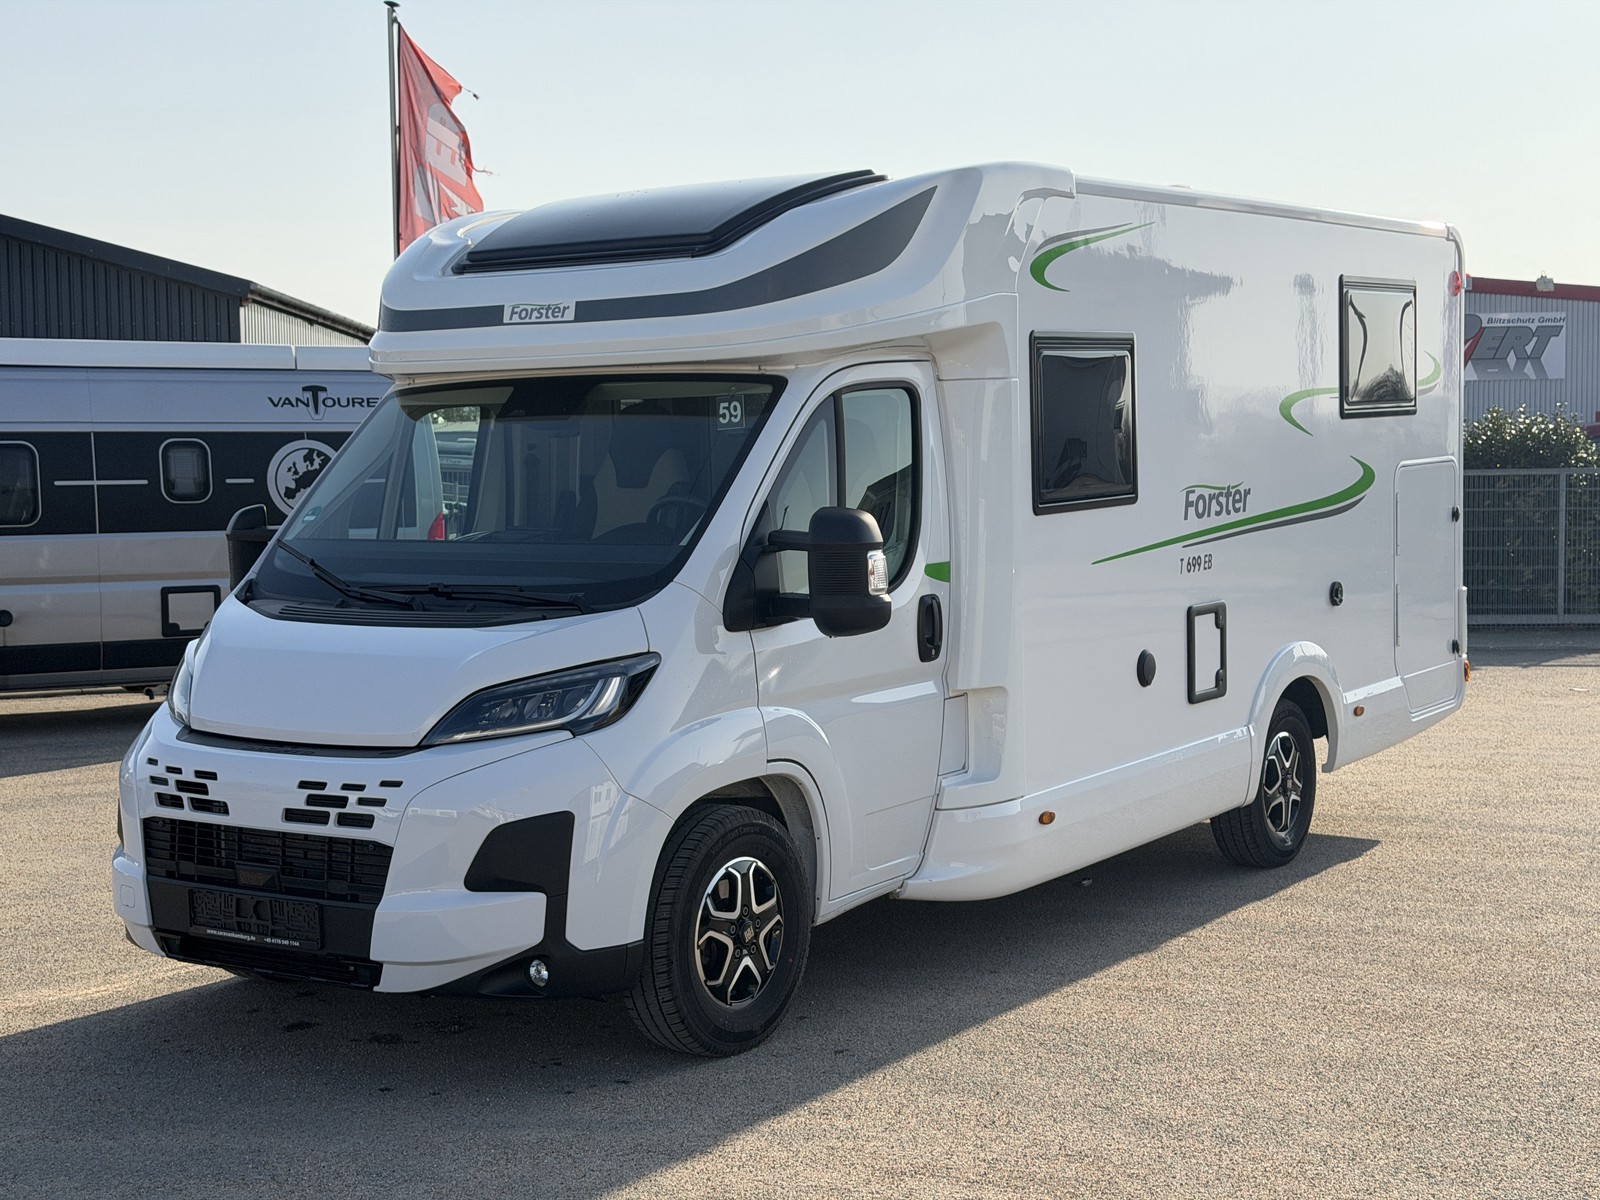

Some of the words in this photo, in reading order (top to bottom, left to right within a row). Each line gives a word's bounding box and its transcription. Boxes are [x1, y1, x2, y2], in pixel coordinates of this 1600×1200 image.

[508, 303, 570, 321] Forster
[1486, 316, 1536, 325] Blitzschutz
[1537, 316, 1566, 324] GmbH
[267, 385, 382, 415] VANTOURE
[718, 401, 742, 424] 59
[1183, 484, 1252, 521] Forster
[1179, 558, 1185, 575] T
[1186, 555, 1202, 574] 699
[1203, 553, 1213, 571] EB
